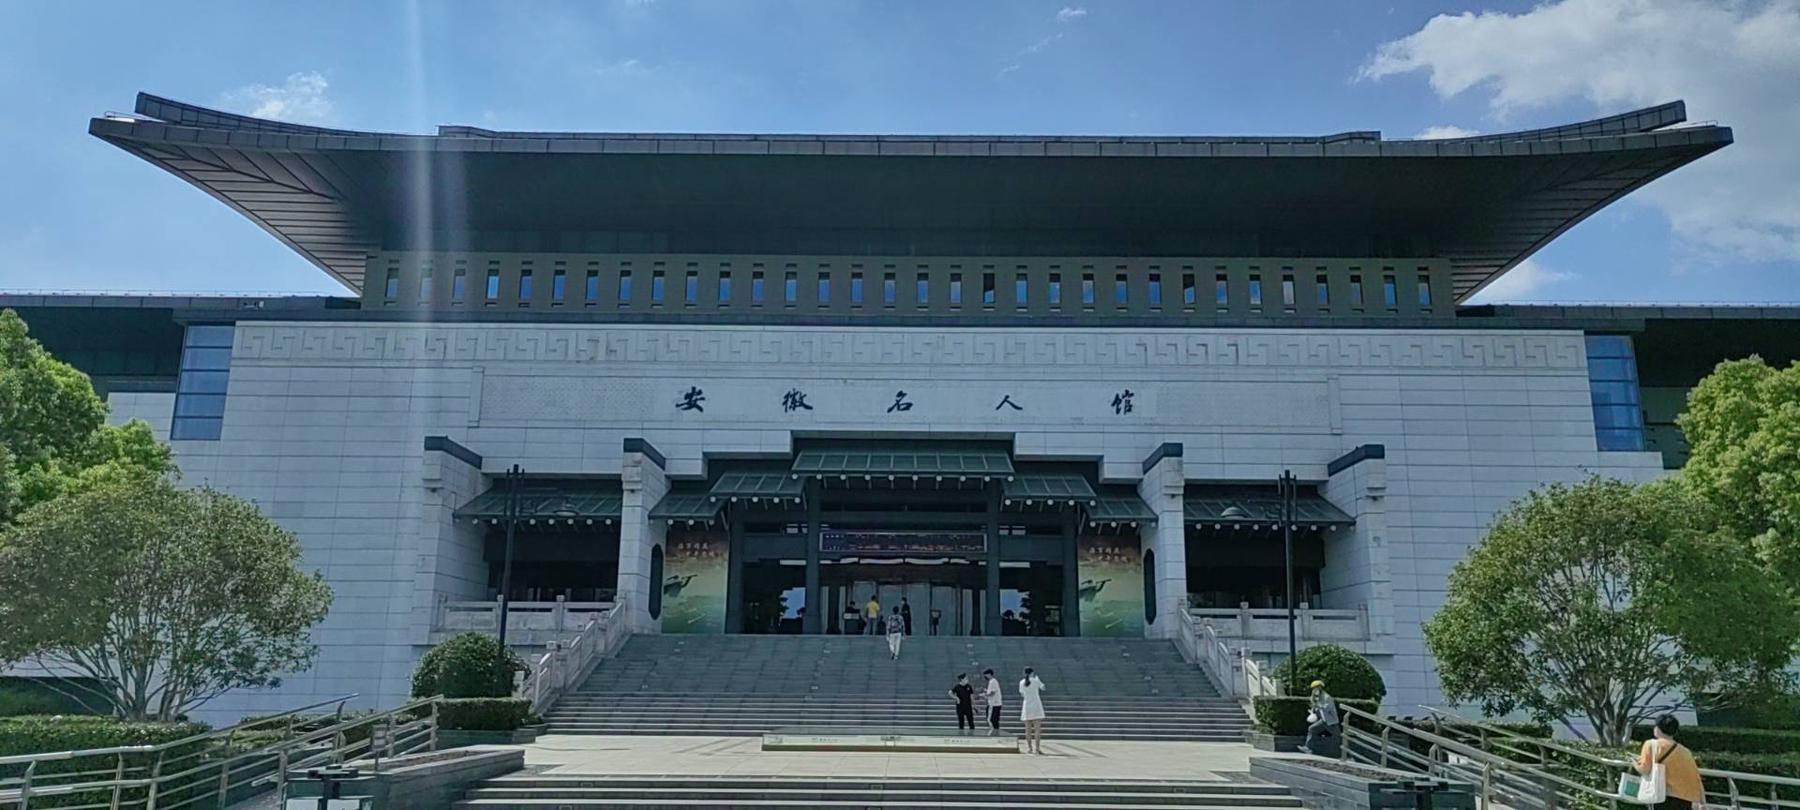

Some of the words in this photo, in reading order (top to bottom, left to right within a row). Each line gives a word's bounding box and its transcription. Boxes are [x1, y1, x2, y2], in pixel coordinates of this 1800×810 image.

[675, 386, 1135, 415] 安徽名人馆
